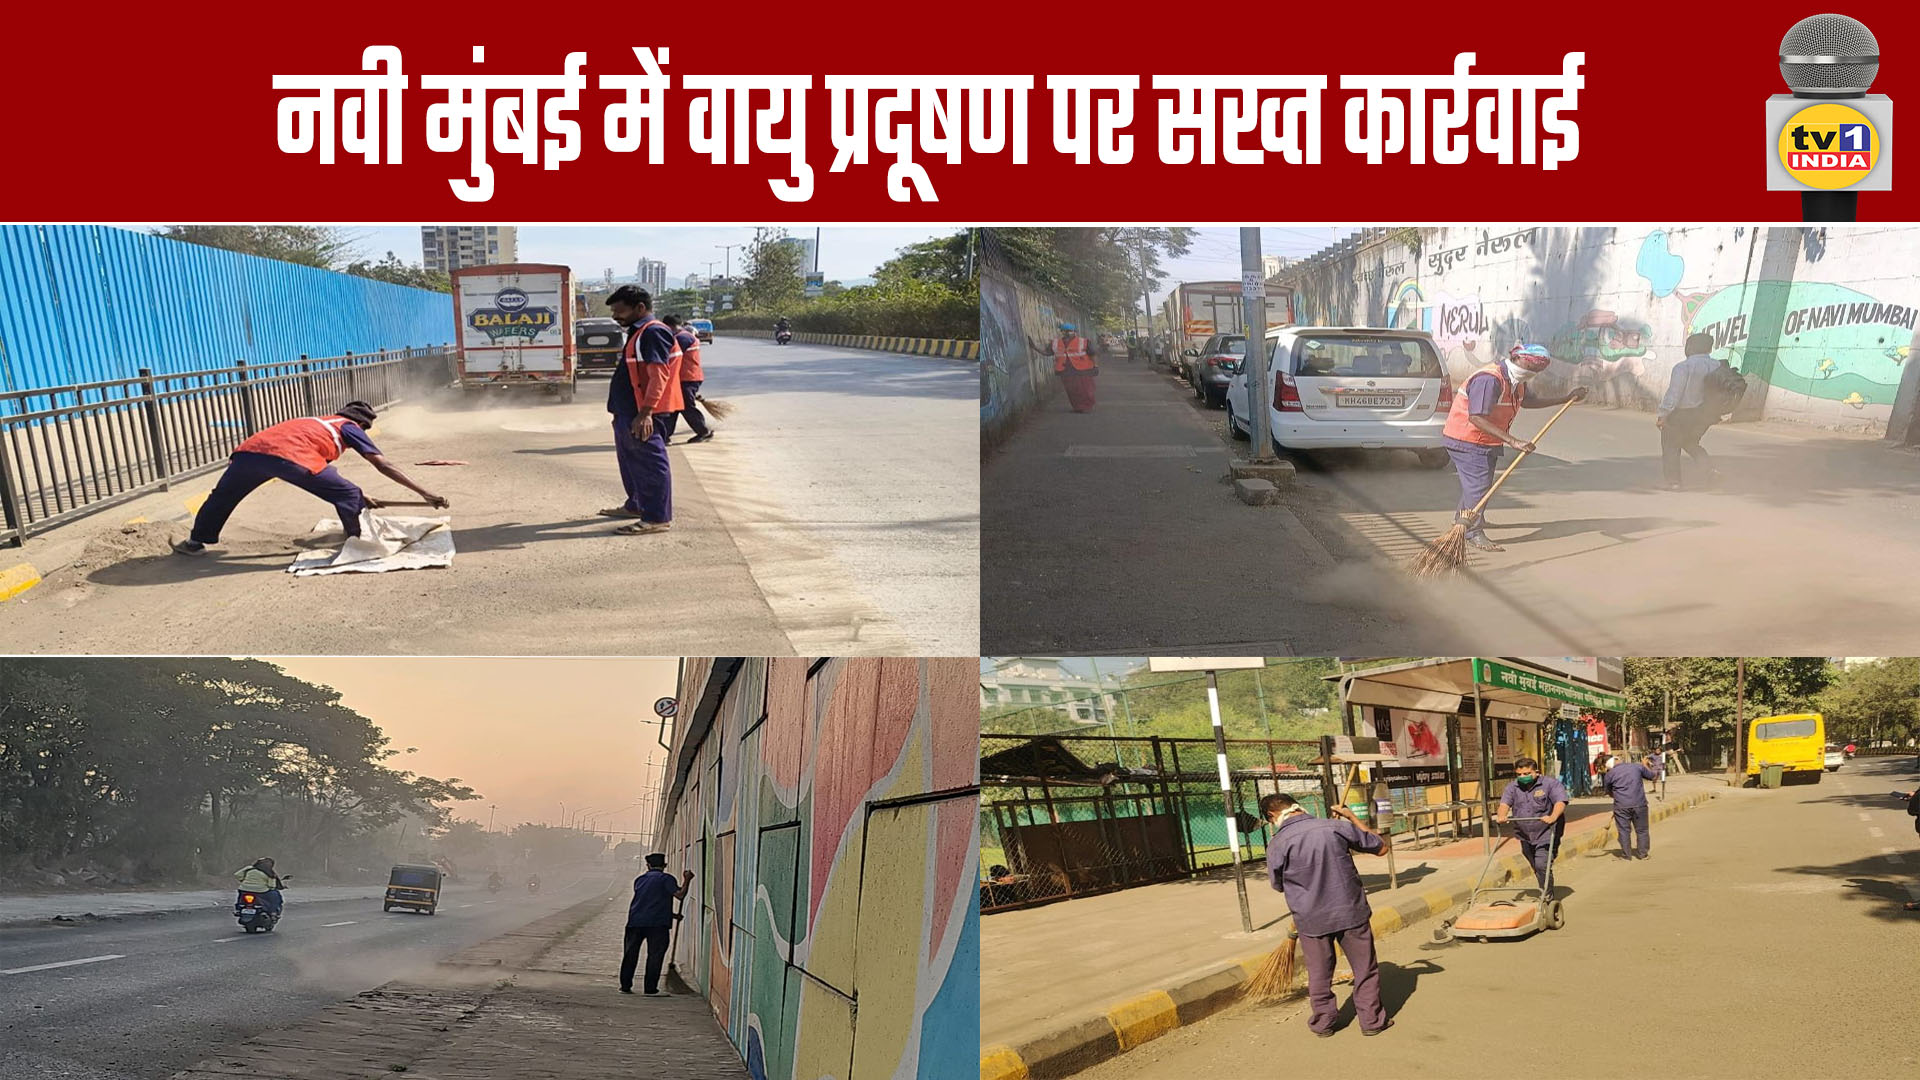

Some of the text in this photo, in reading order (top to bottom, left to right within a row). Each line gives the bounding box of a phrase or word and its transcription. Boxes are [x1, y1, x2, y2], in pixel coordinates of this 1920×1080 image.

[474, 312, 551, 327] BALAJI
[1440, 302, 1489, 339] NERUL
[1701, 302, 1919, 350] WEL OF NAVI MUMBAI
[1501, 671, 1517, 685] नवी
[1519, 673, 1537, 691] मुंबई
